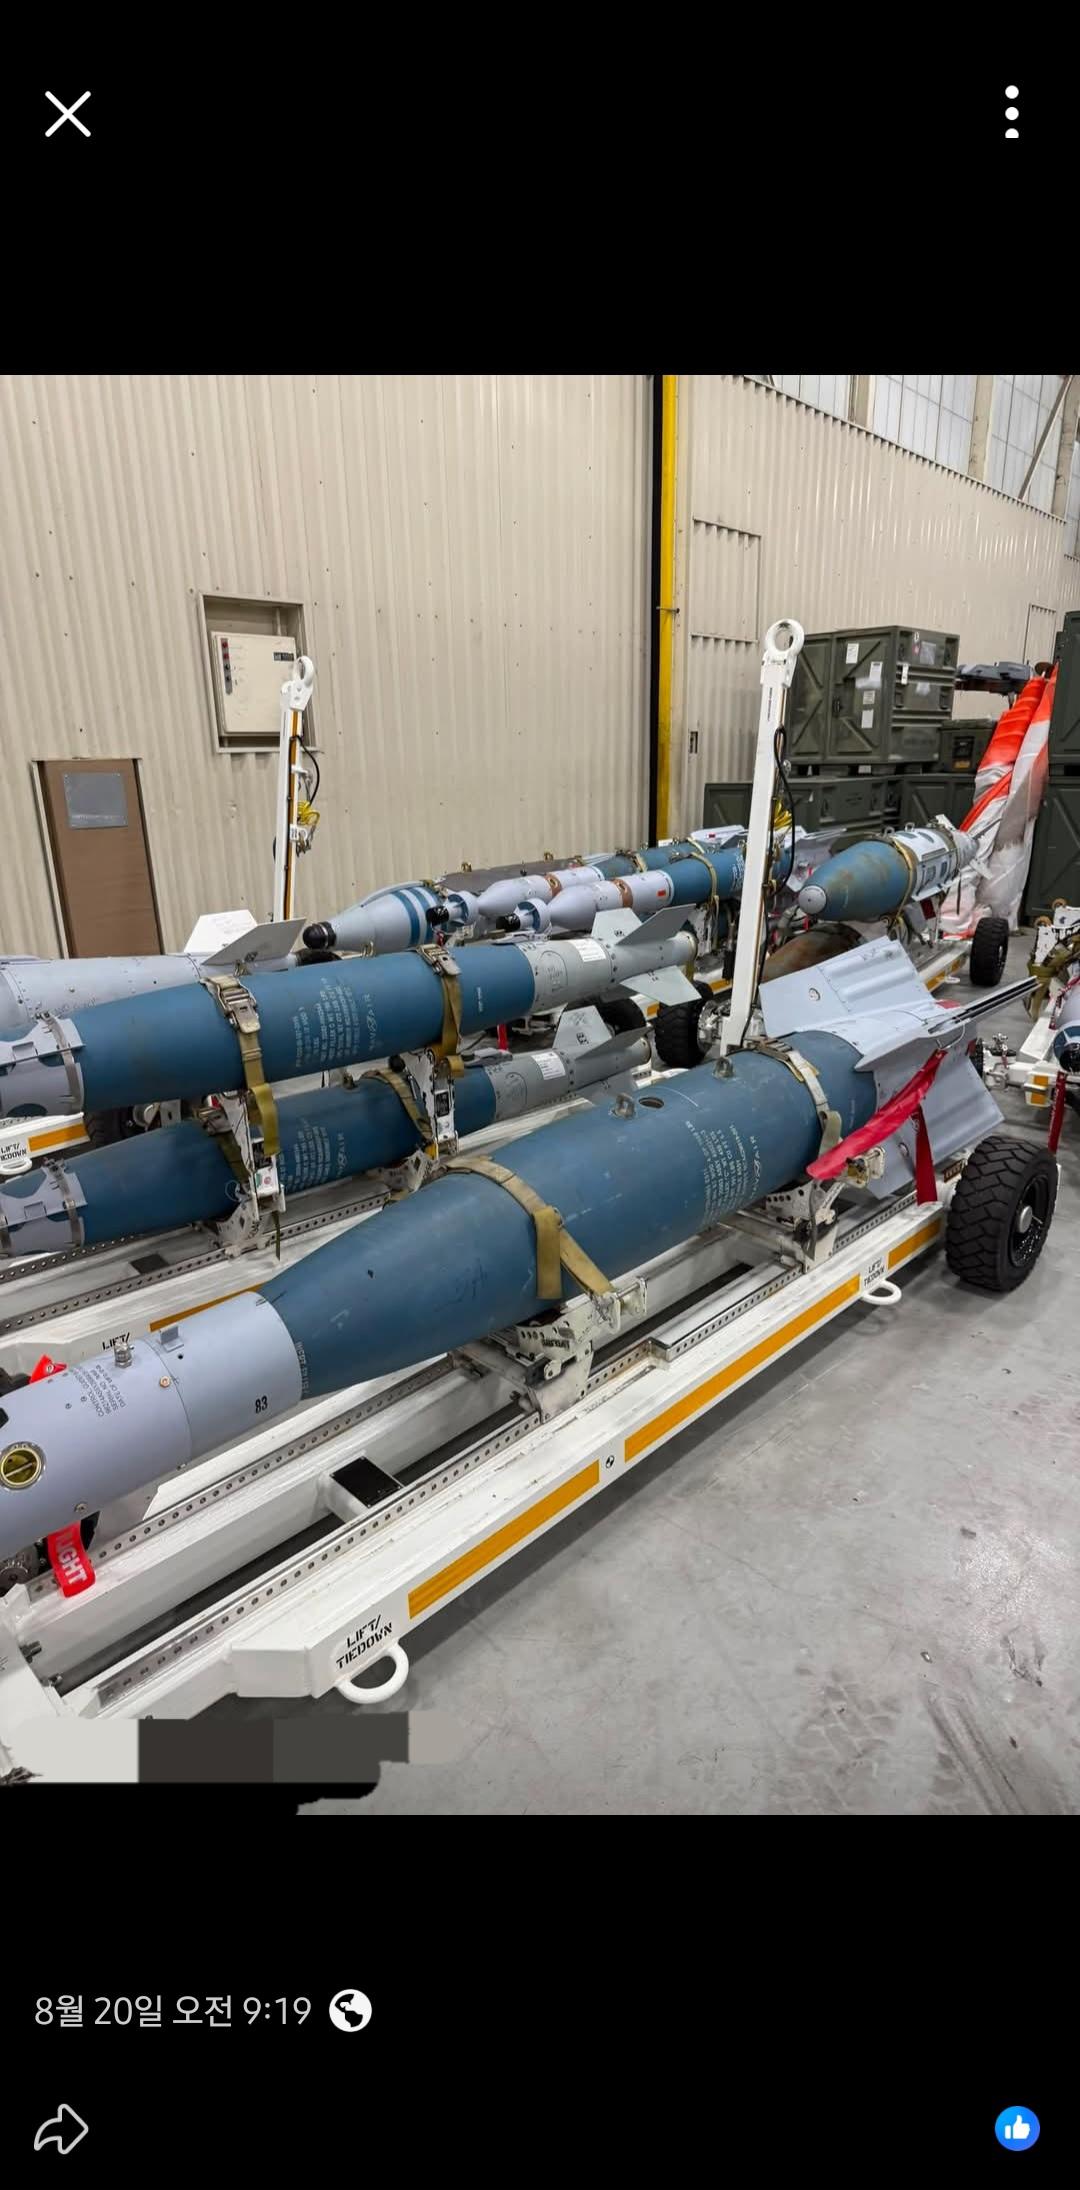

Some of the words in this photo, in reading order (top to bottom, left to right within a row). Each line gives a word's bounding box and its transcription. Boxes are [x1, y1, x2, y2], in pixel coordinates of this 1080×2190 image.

[0, 1143, 20, 1154] LIFT/
[0, 1148, 27, 1161] IEDOWN
[255, 1395, 268, 1414] 83
[55, 1532, 88, 1585] LIGHT
[346, 1614, 381, 1648] LIFT/
[335, 1622, 392, 1669] TIEDOWN
